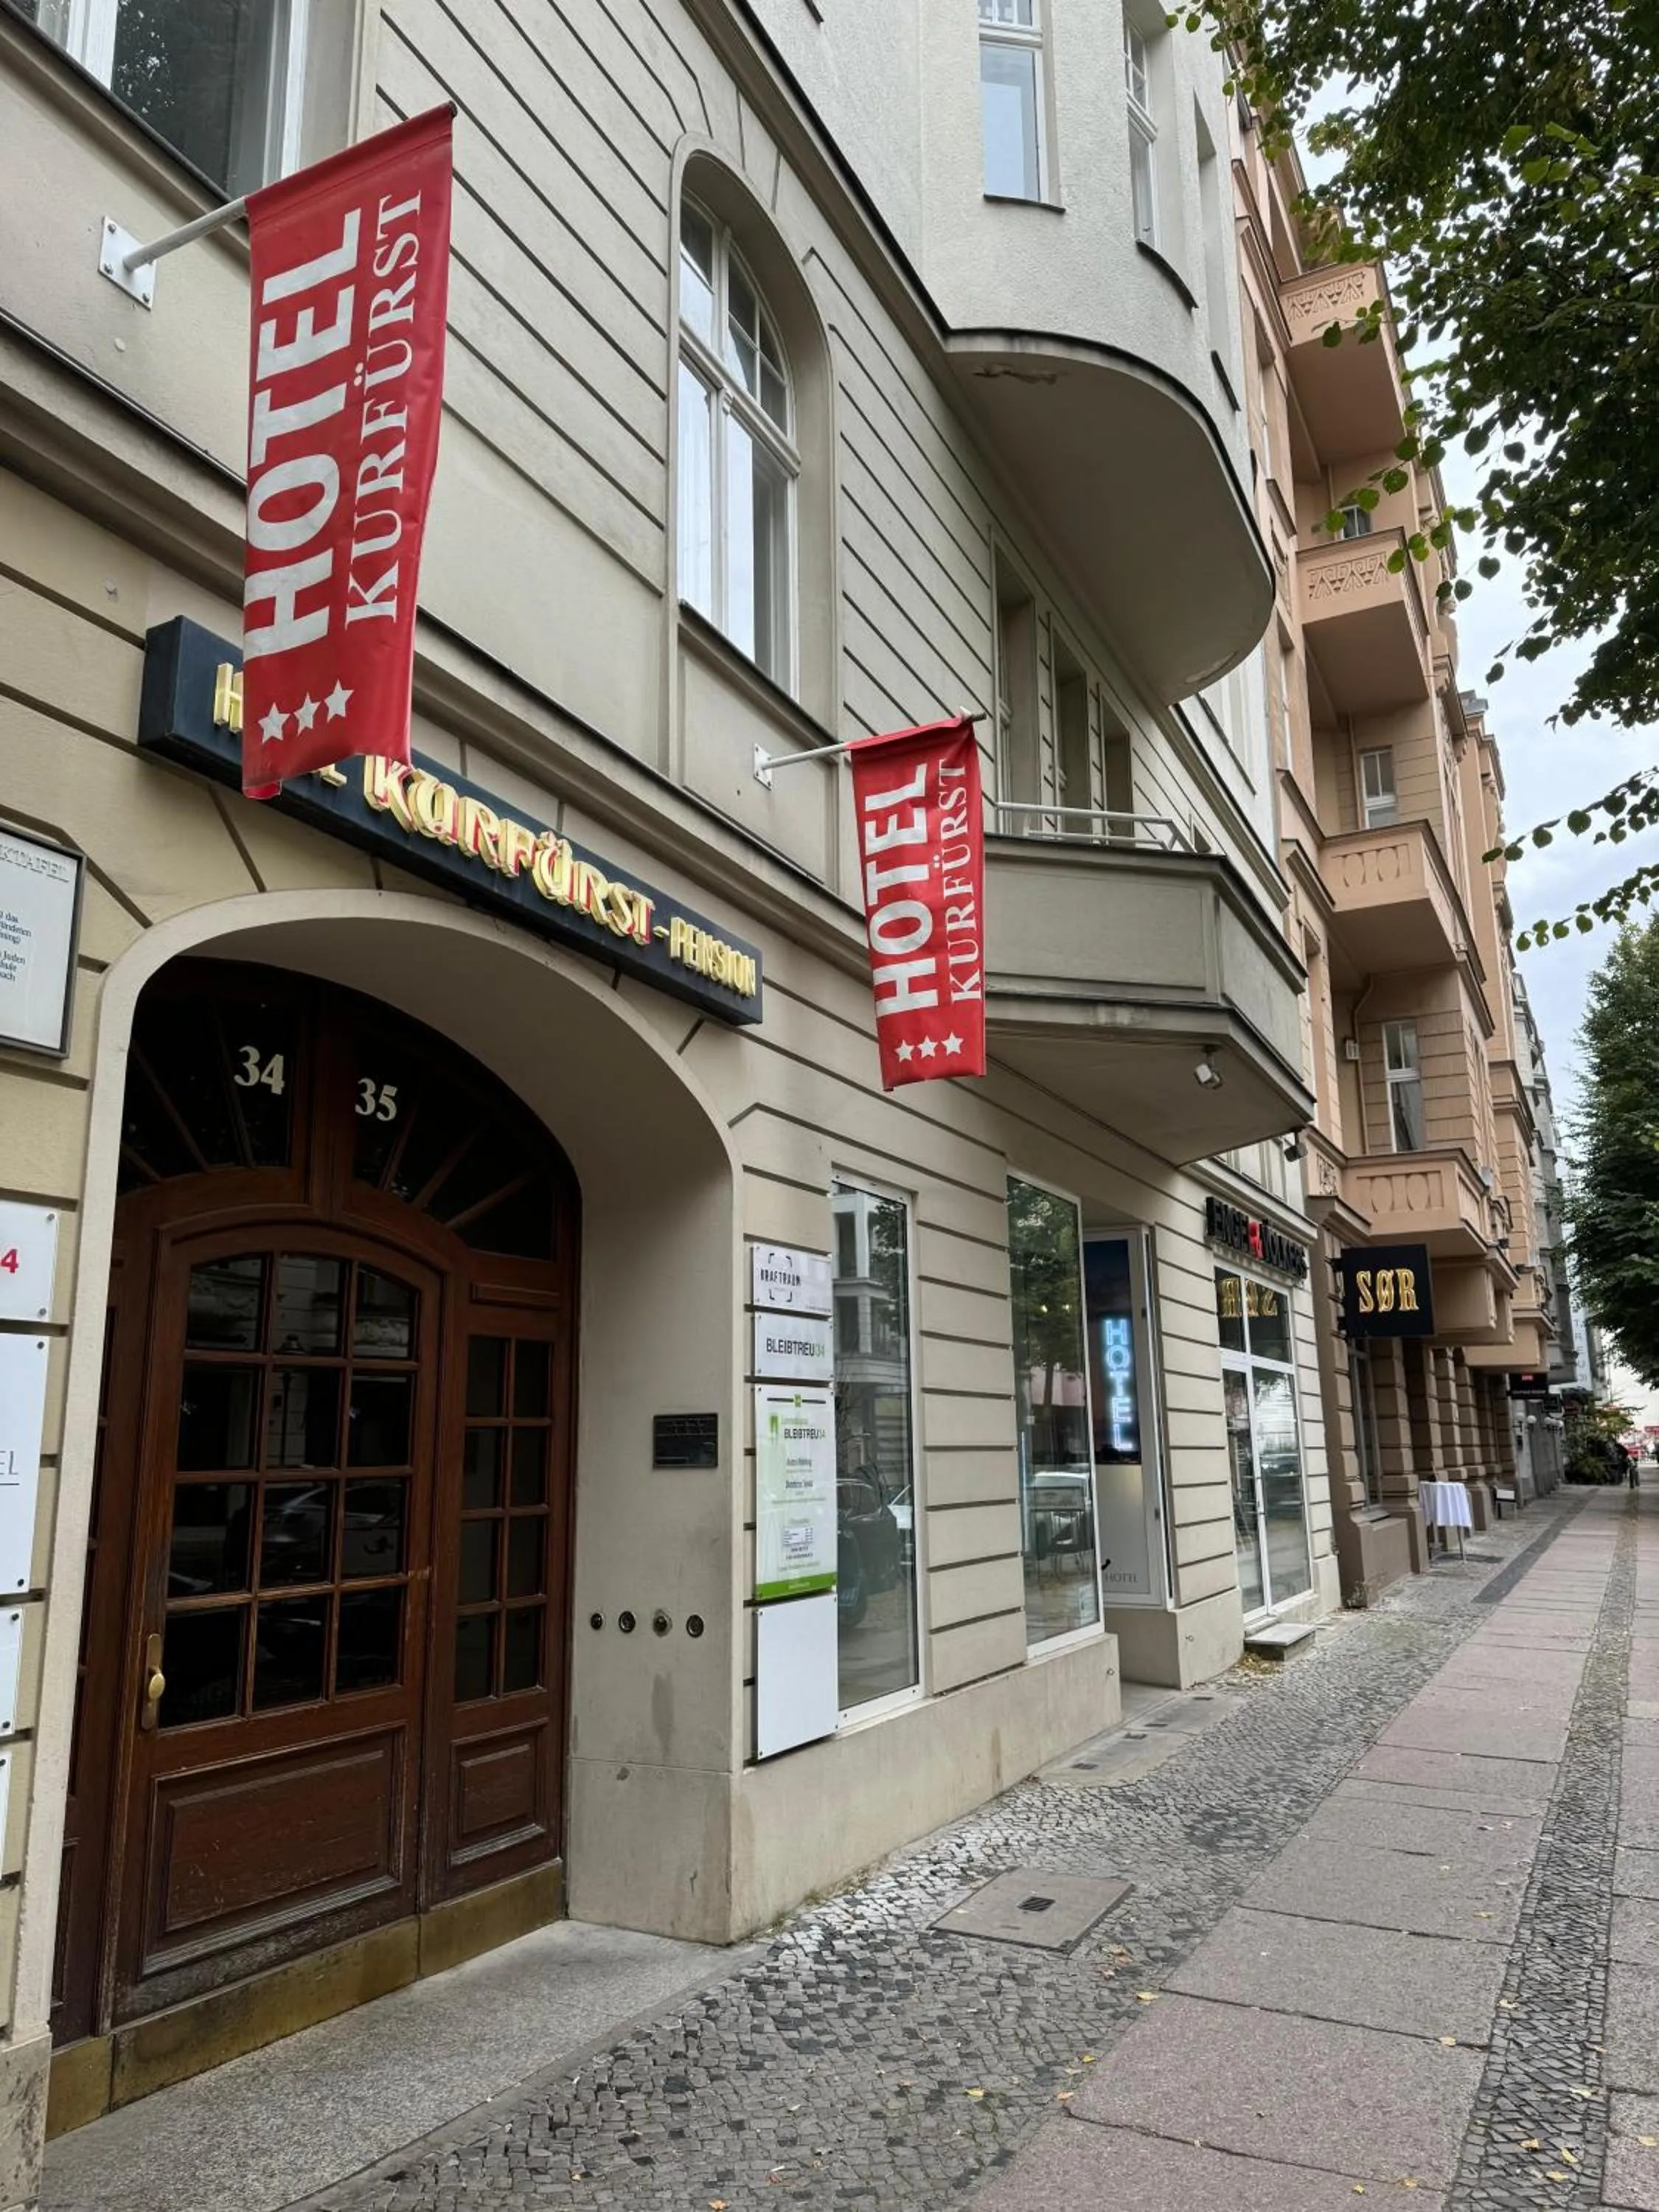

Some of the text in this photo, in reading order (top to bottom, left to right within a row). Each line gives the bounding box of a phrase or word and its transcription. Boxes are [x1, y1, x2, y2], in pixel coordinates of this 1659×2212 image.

[244, 208, 361, 658] HOTEL
[344, 189, 422, 627] KURFÜRST
[864, 762, 939, 1017] HOTEL
[933, 758, 982, 1004] KURFÜRST
[234, 1046, 285, 1094] 34
[355, 1077, 397, 1121] 35
[1105, 1318, 1133, 1452] HOTEL
